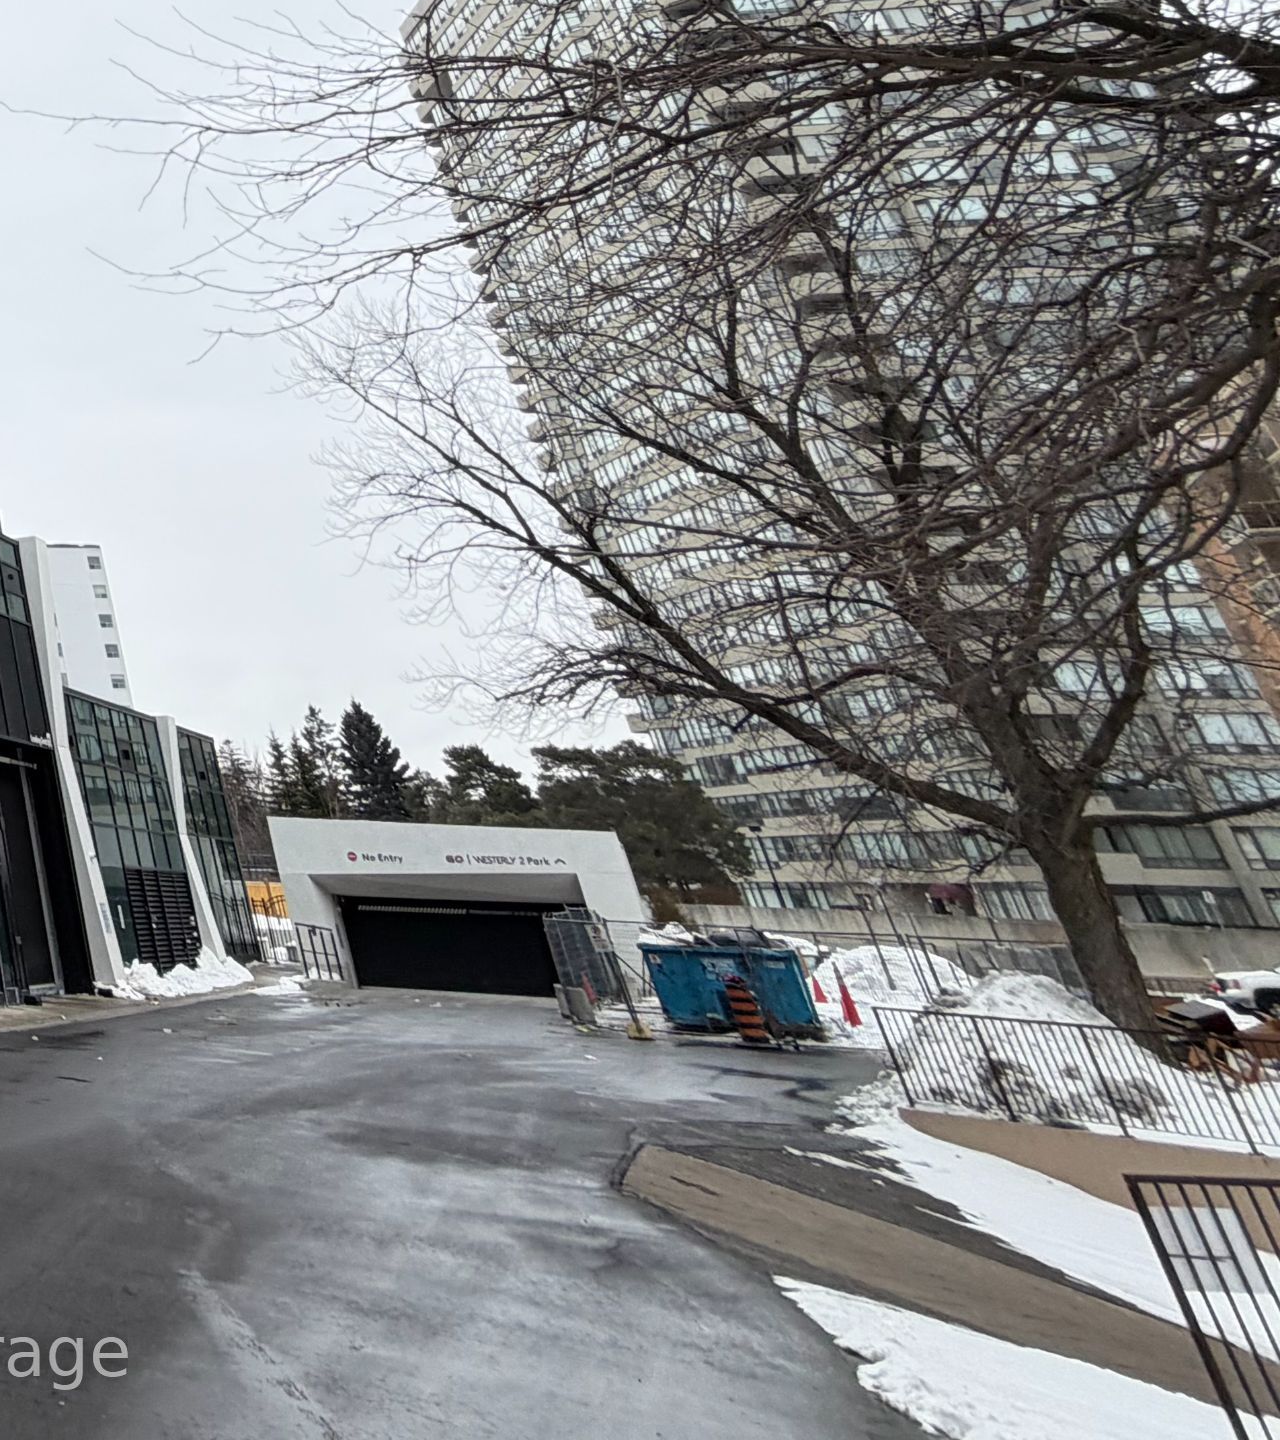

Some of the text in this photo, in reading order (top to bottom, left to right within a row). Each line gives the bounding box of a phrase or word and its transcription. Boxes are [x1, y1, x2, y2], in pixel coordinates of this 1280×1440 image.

[361, 853, 403, 864] No Entry
[472, 855, 516, 865] WESTERLY
[519, 856, 525, 865] 2
[527, 857, 550, 866] Park
